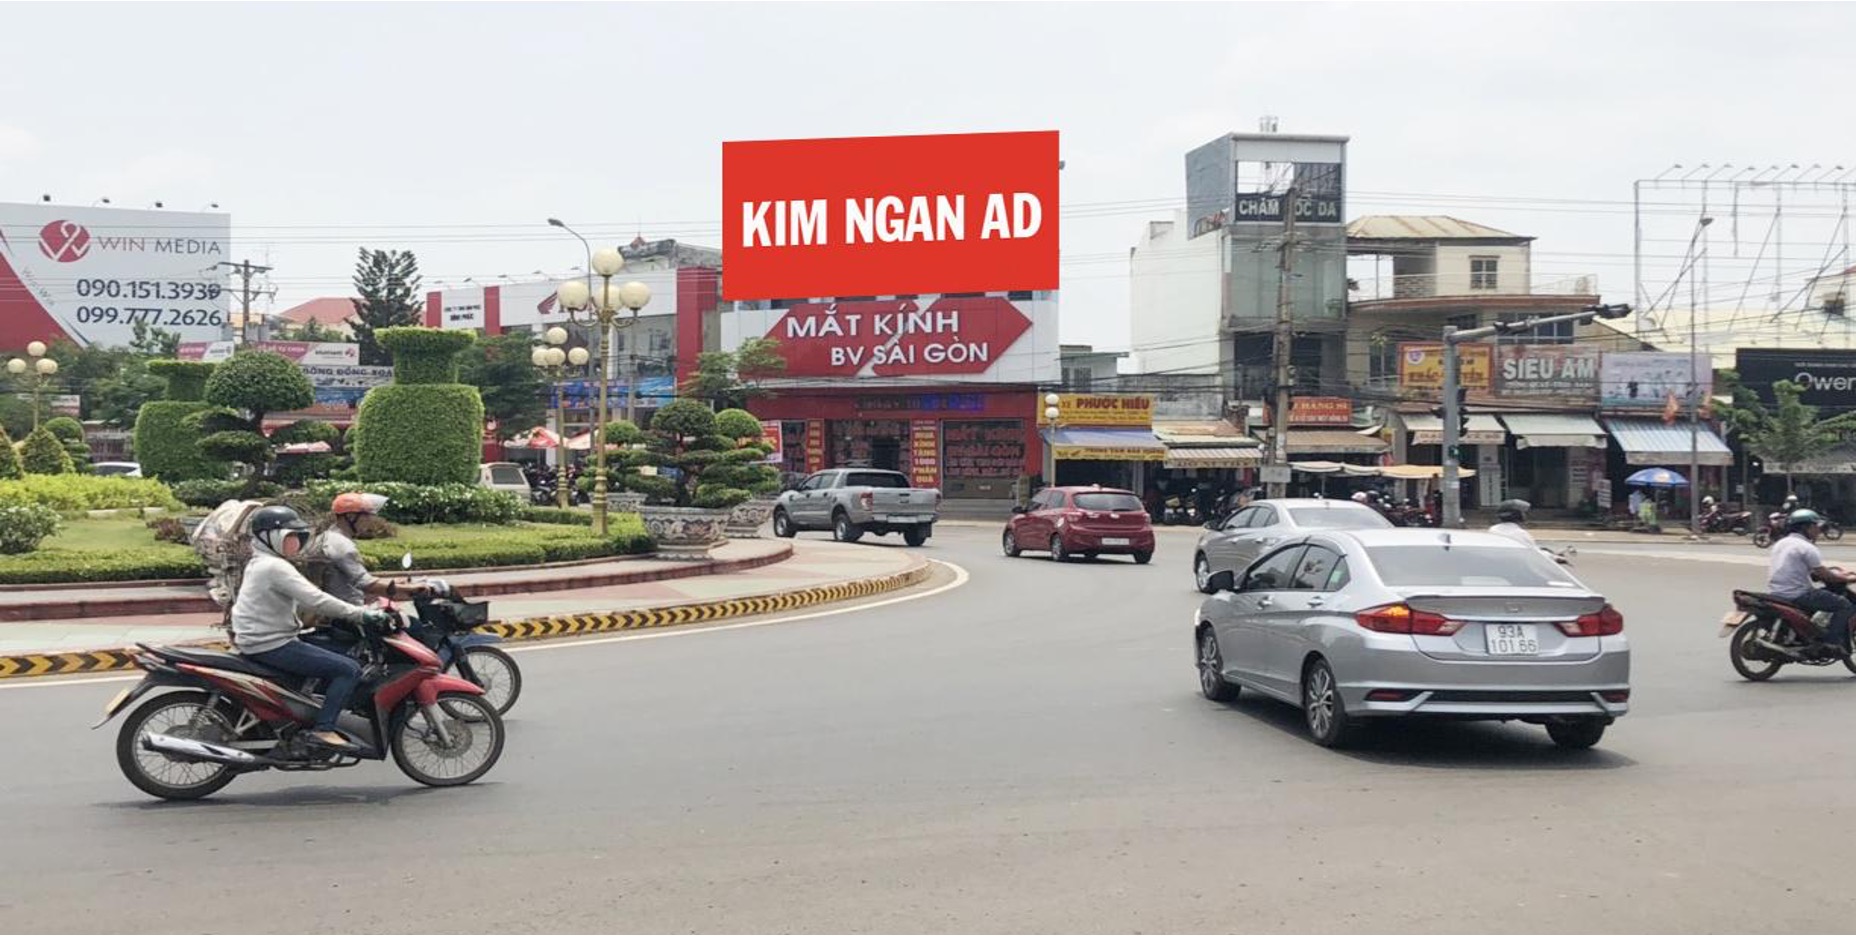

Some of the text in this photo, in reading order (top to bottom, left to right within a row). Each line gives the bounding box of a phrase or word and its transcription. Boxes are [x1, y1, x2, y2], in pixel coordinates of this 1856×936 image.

[98, 236, 221, 255] WIN MEDIA
[77, 306, 222, 326] 099.777.2626
[786, 303, 959, 338] MẮT KÍNH
[830, 346, 865, 366] BV
[923, 336, 988, 363] GÒN
[1497, 625, 1526, 639] 93A
